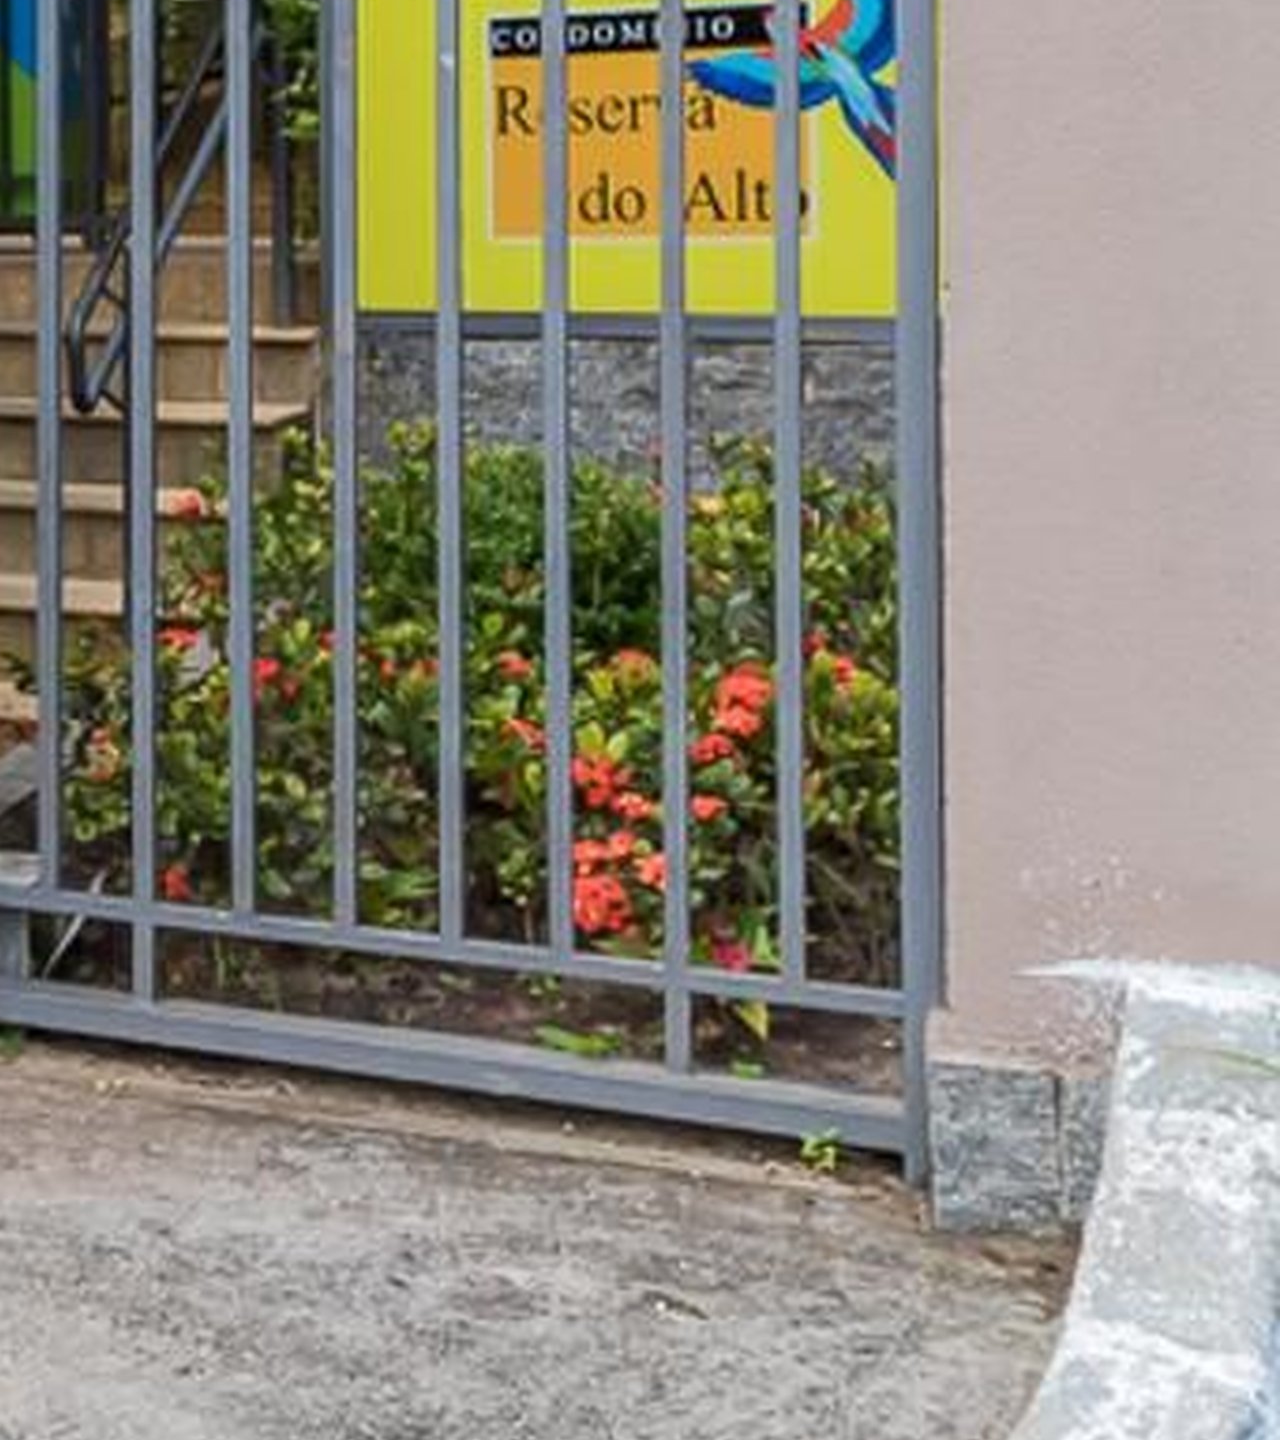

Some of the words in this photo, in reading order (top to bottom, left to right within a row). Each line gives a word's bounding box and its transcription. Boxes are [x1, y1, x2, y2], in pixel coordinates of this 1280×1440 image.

[496, 82, 717, 136] Rsera
[577, 171, 647, 223] do
[683, 167, 808, 223] Alt
